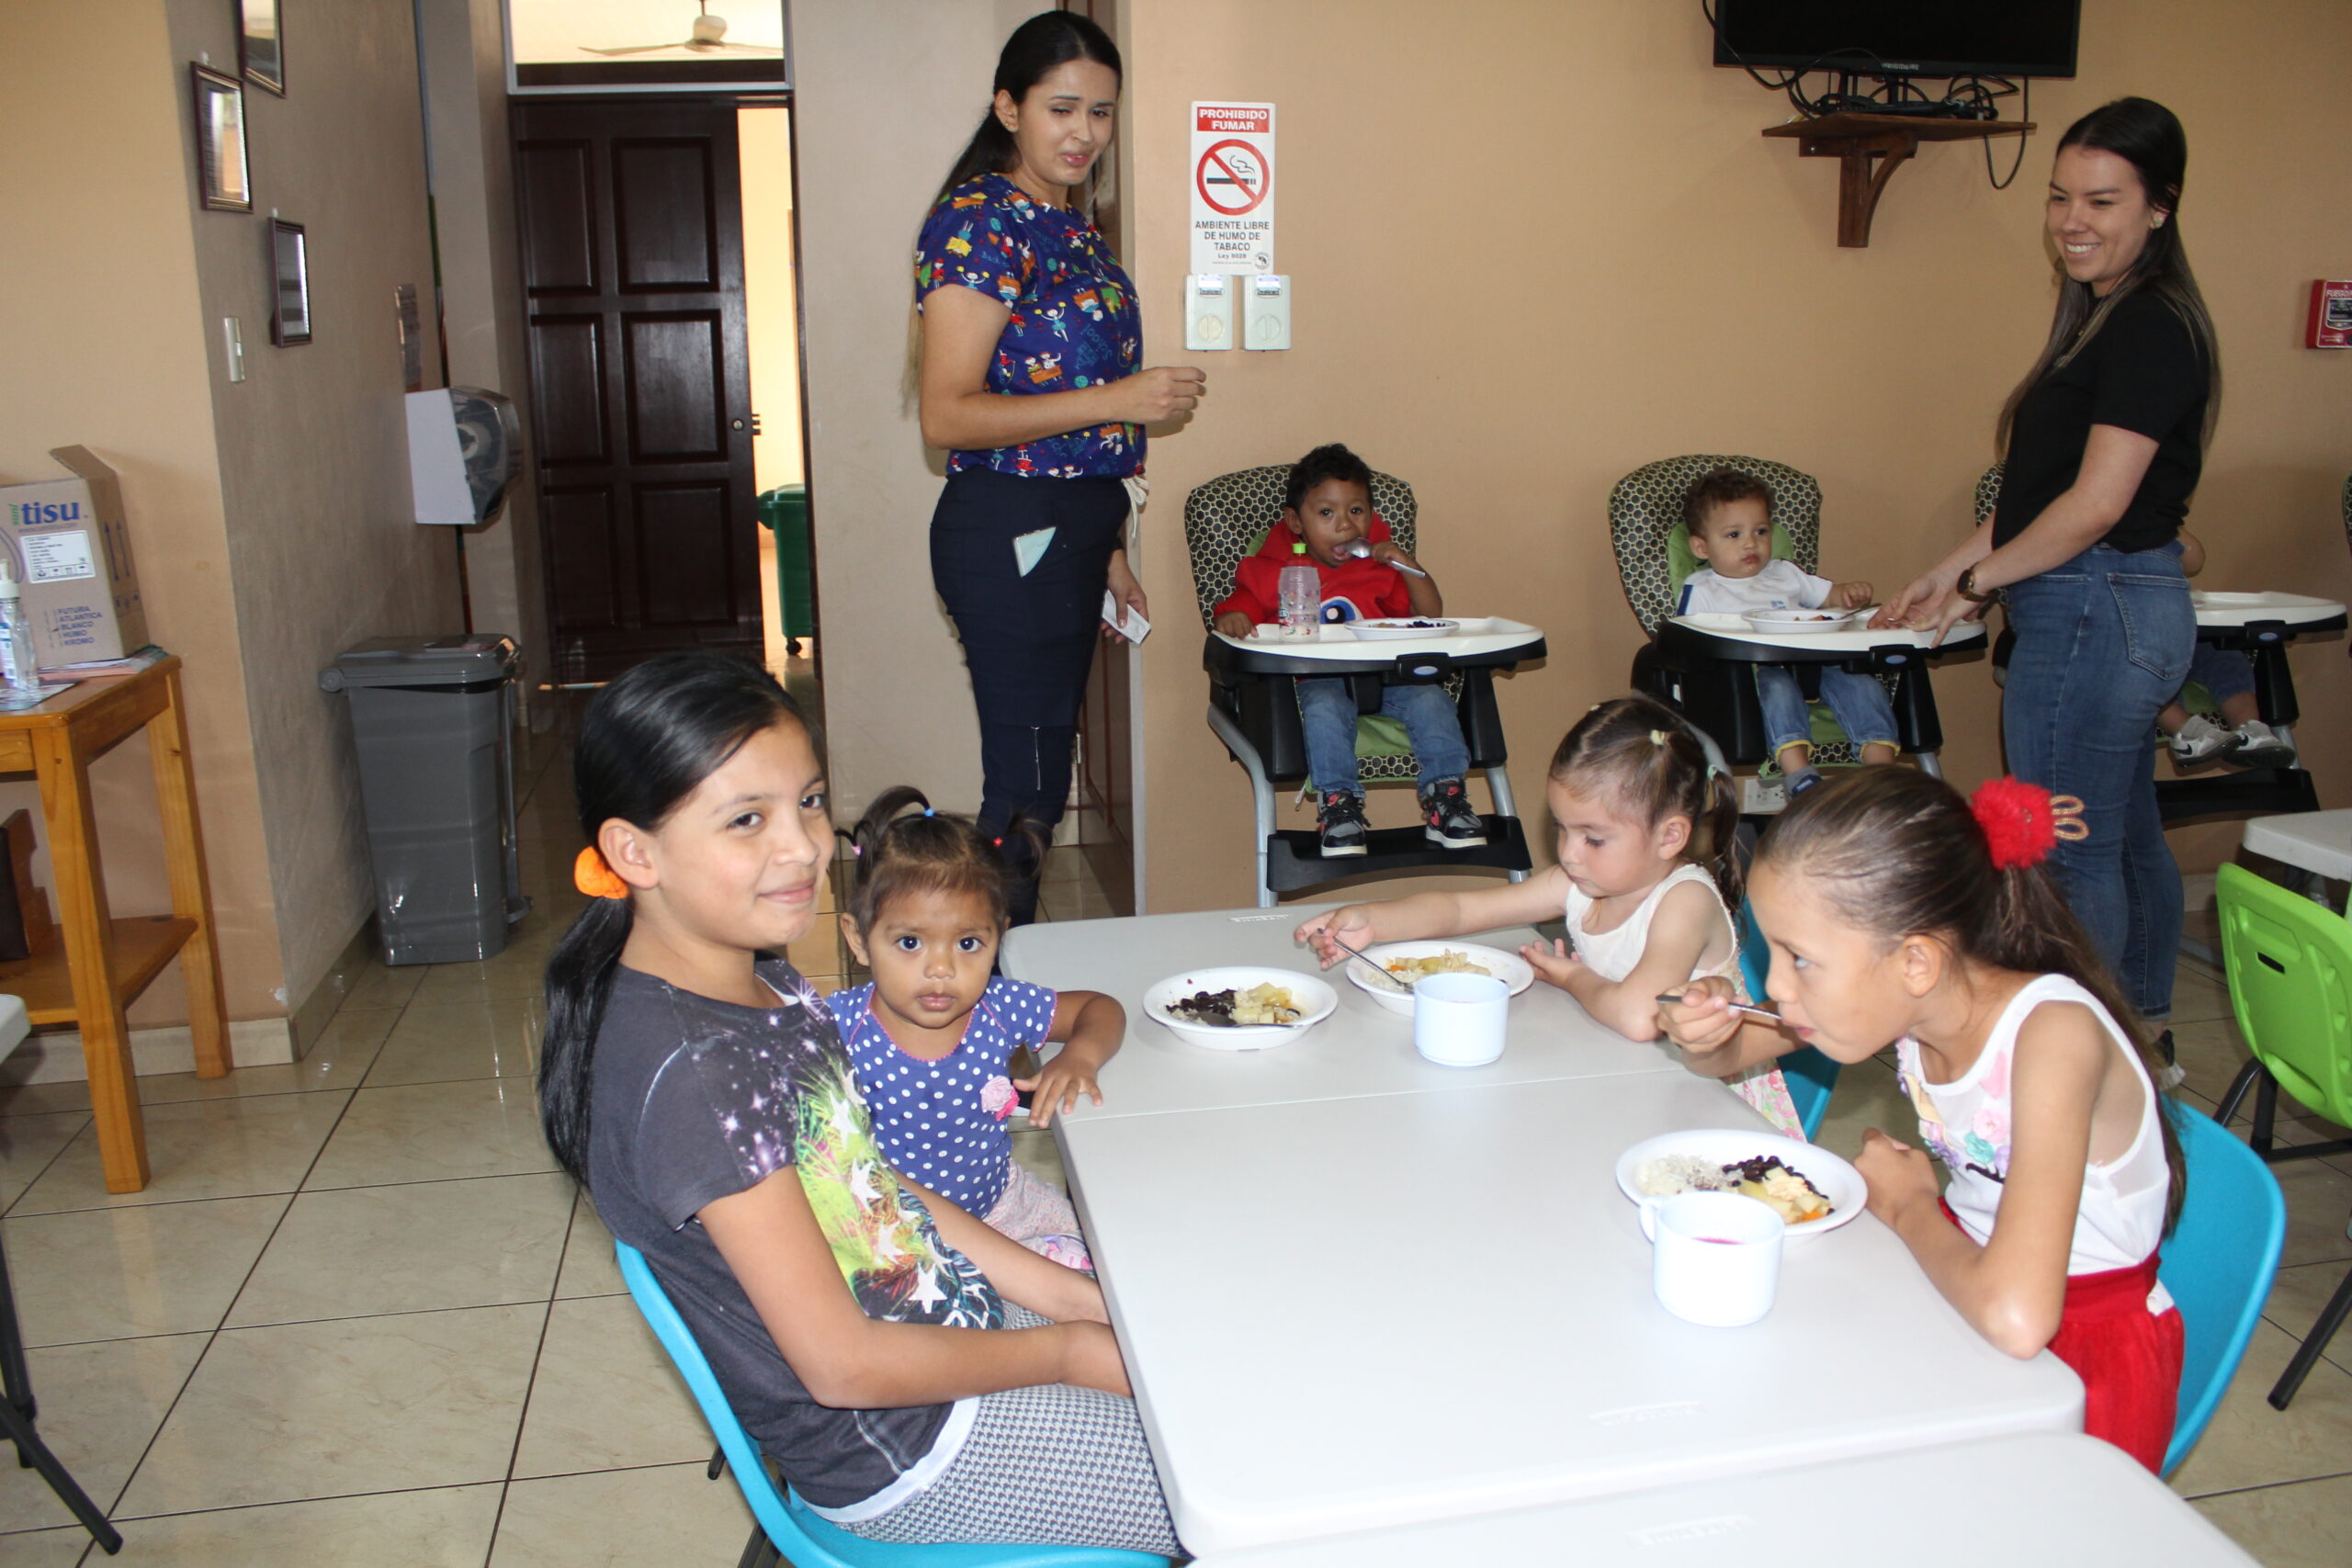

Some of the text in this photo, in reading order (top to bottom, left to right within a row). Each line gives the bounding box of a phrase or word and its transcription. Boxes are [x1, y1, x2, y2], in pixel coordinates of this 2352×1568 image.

[1199, 108, 1268, 119] PROHIBIDO
[1212, 120, 1255, 130] FUMAR
[1195, 220, 1270, 230] AMBIENTE LIBRE
[1204, 231, 1261, 240] DE HUMO DE
[1214, 243, 1250, 251] TABACO
[21, 502, 80, 525] tisu
[59, 612, 103, 622] ATLANTICA
[61, 620, 95, 630] BLANCO
